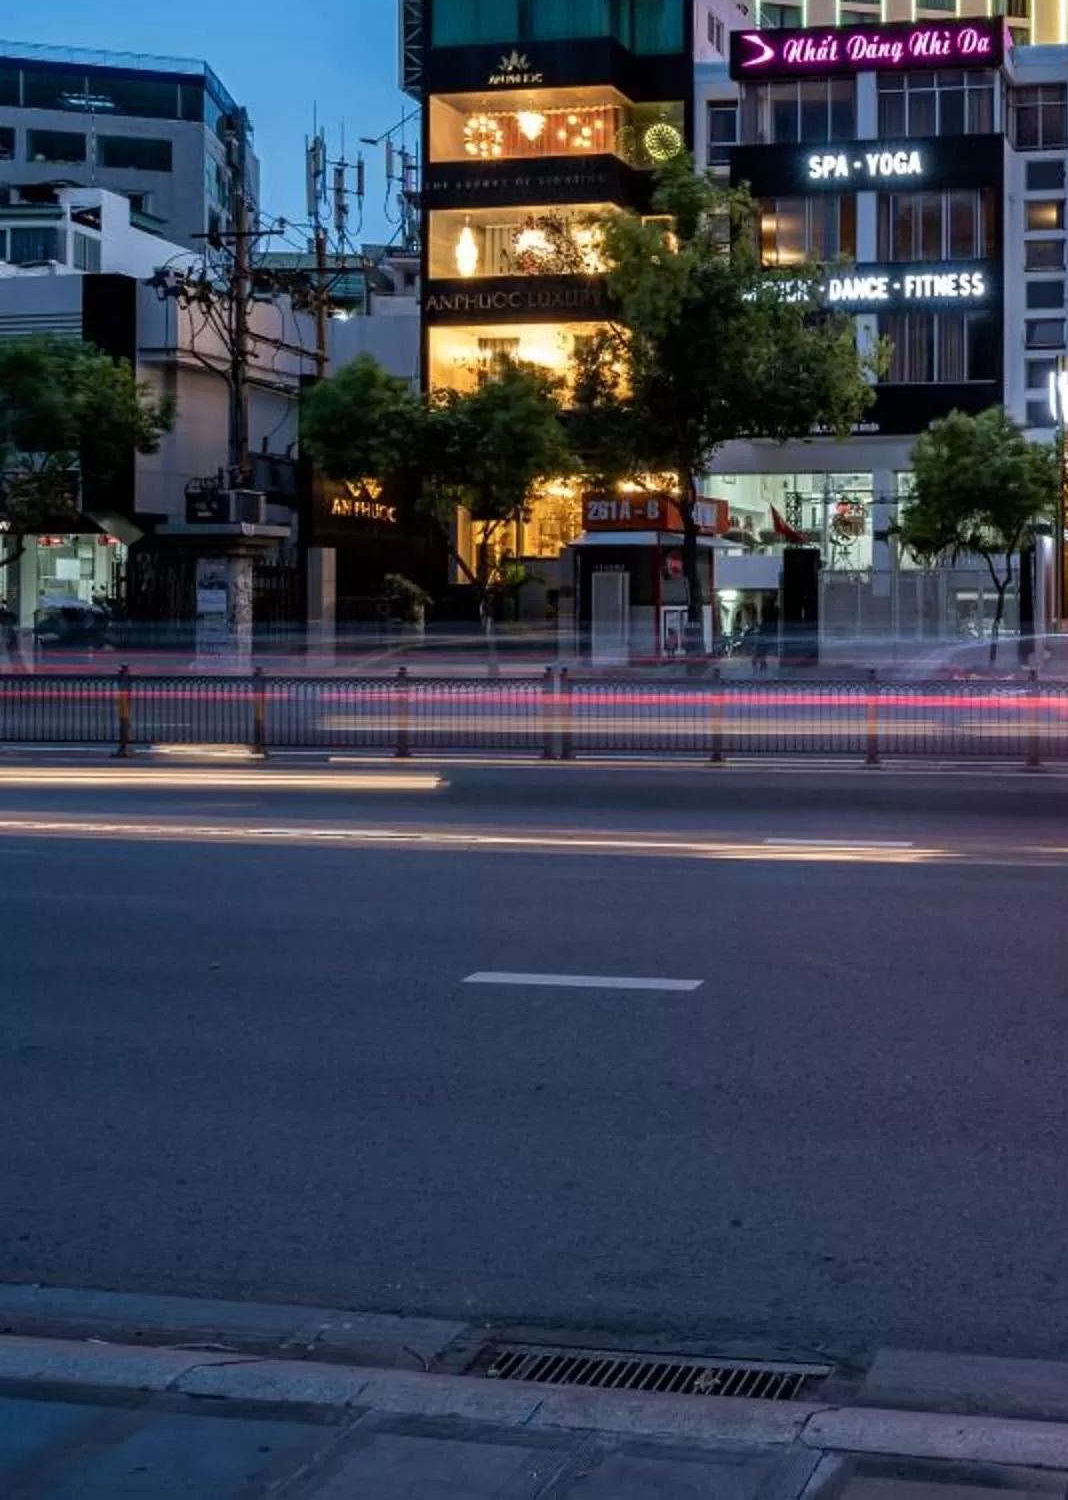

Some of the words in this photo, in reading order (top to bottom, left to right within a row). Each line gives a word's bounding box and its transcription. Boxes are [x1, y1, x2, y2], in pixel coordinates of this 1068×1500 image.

[957, 28, 990, 53] Da
[808, 154, 849, 179] SPA
[865, 151, 922, 177] YOGA
[828, 277, 889, 301] DANCE
[904, 273, 985, 298] FITNESS
